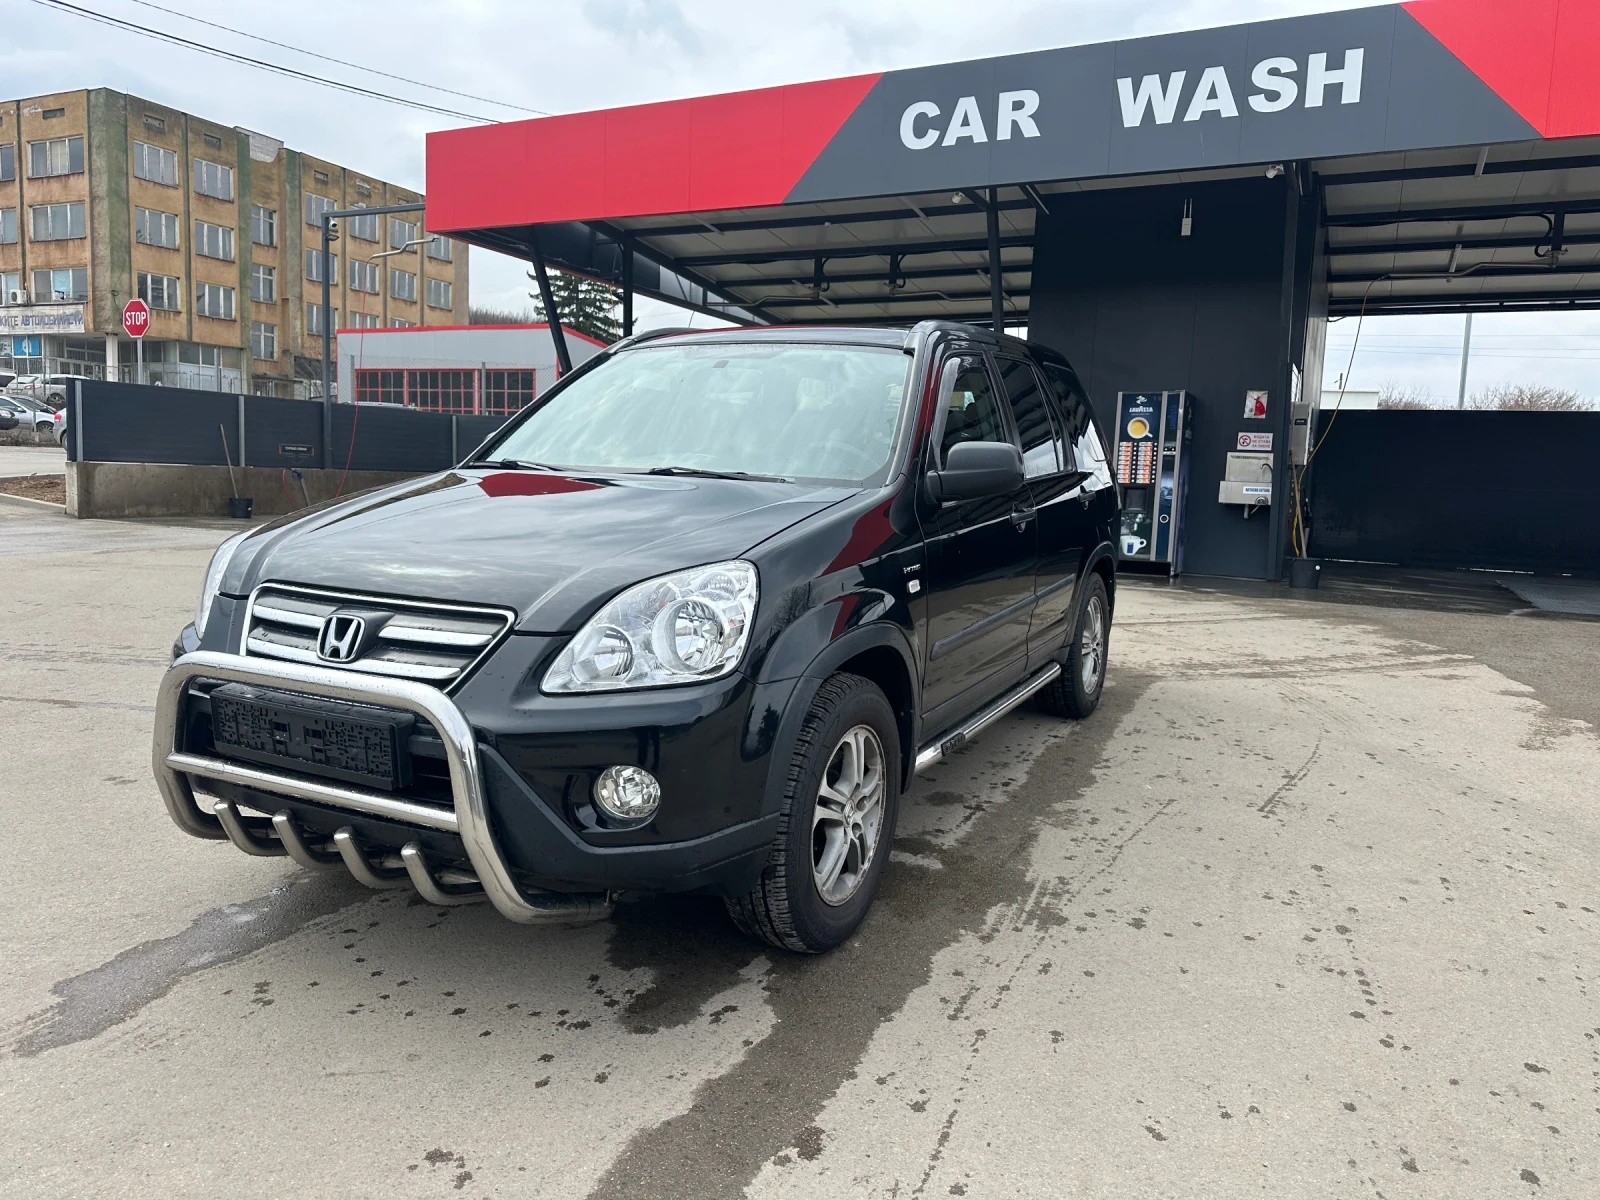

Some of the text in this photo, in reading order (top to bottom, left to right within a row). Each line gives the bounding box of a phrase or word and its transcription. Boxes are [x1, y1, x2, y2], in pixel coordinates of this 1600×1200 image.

[899, 47, 1365, 150] CAR WASH
[125, 311, 147, 325] STOP
